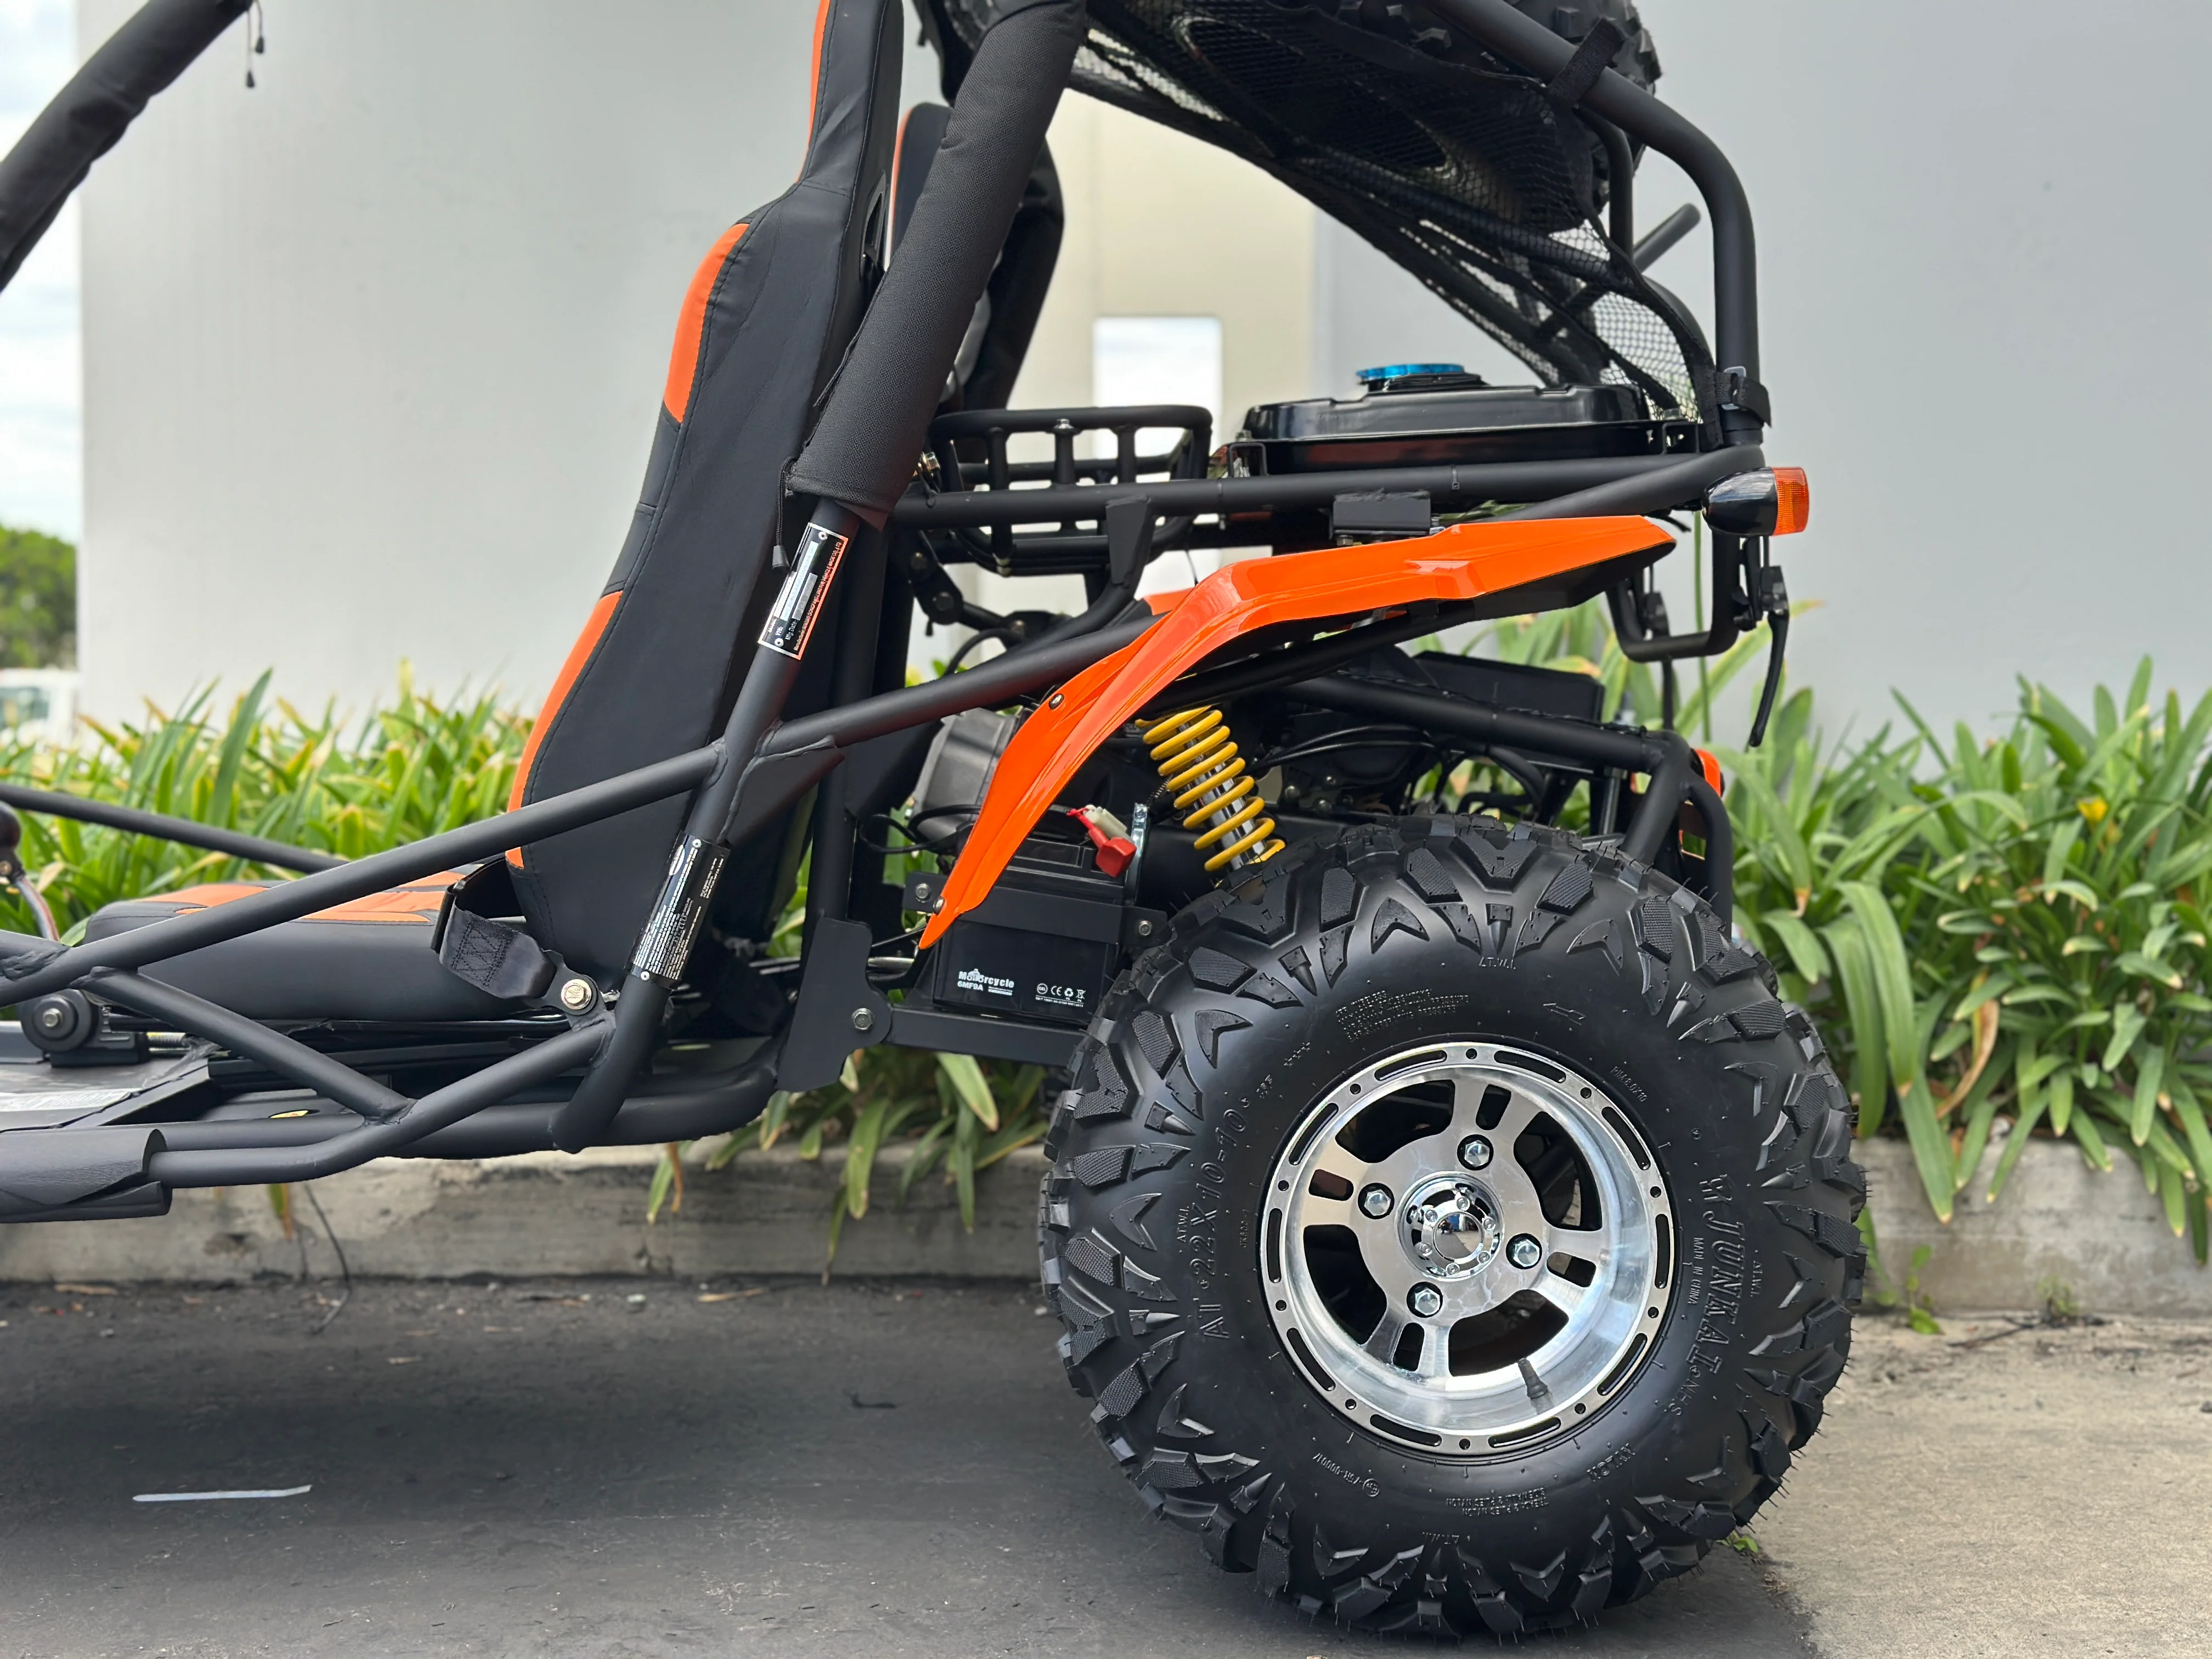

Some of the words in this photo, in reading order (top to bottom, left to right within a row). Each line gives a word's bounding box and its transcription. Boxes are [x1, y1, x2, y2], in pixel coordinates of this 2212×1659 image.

[958, 969, 1014, 988] Motorcycle
[1189, 1109, 1246, 1276] 22X10-10
[1693, 1266, 1703, 1275] IN
[1686, 1211, 1746, 1374] JUNKAI
[1688, 1279, 1701, 1304] CHINA
[1199, 1303, 1229, 1339] AT
[1587, 1442, 1635, 1482] NYLON
